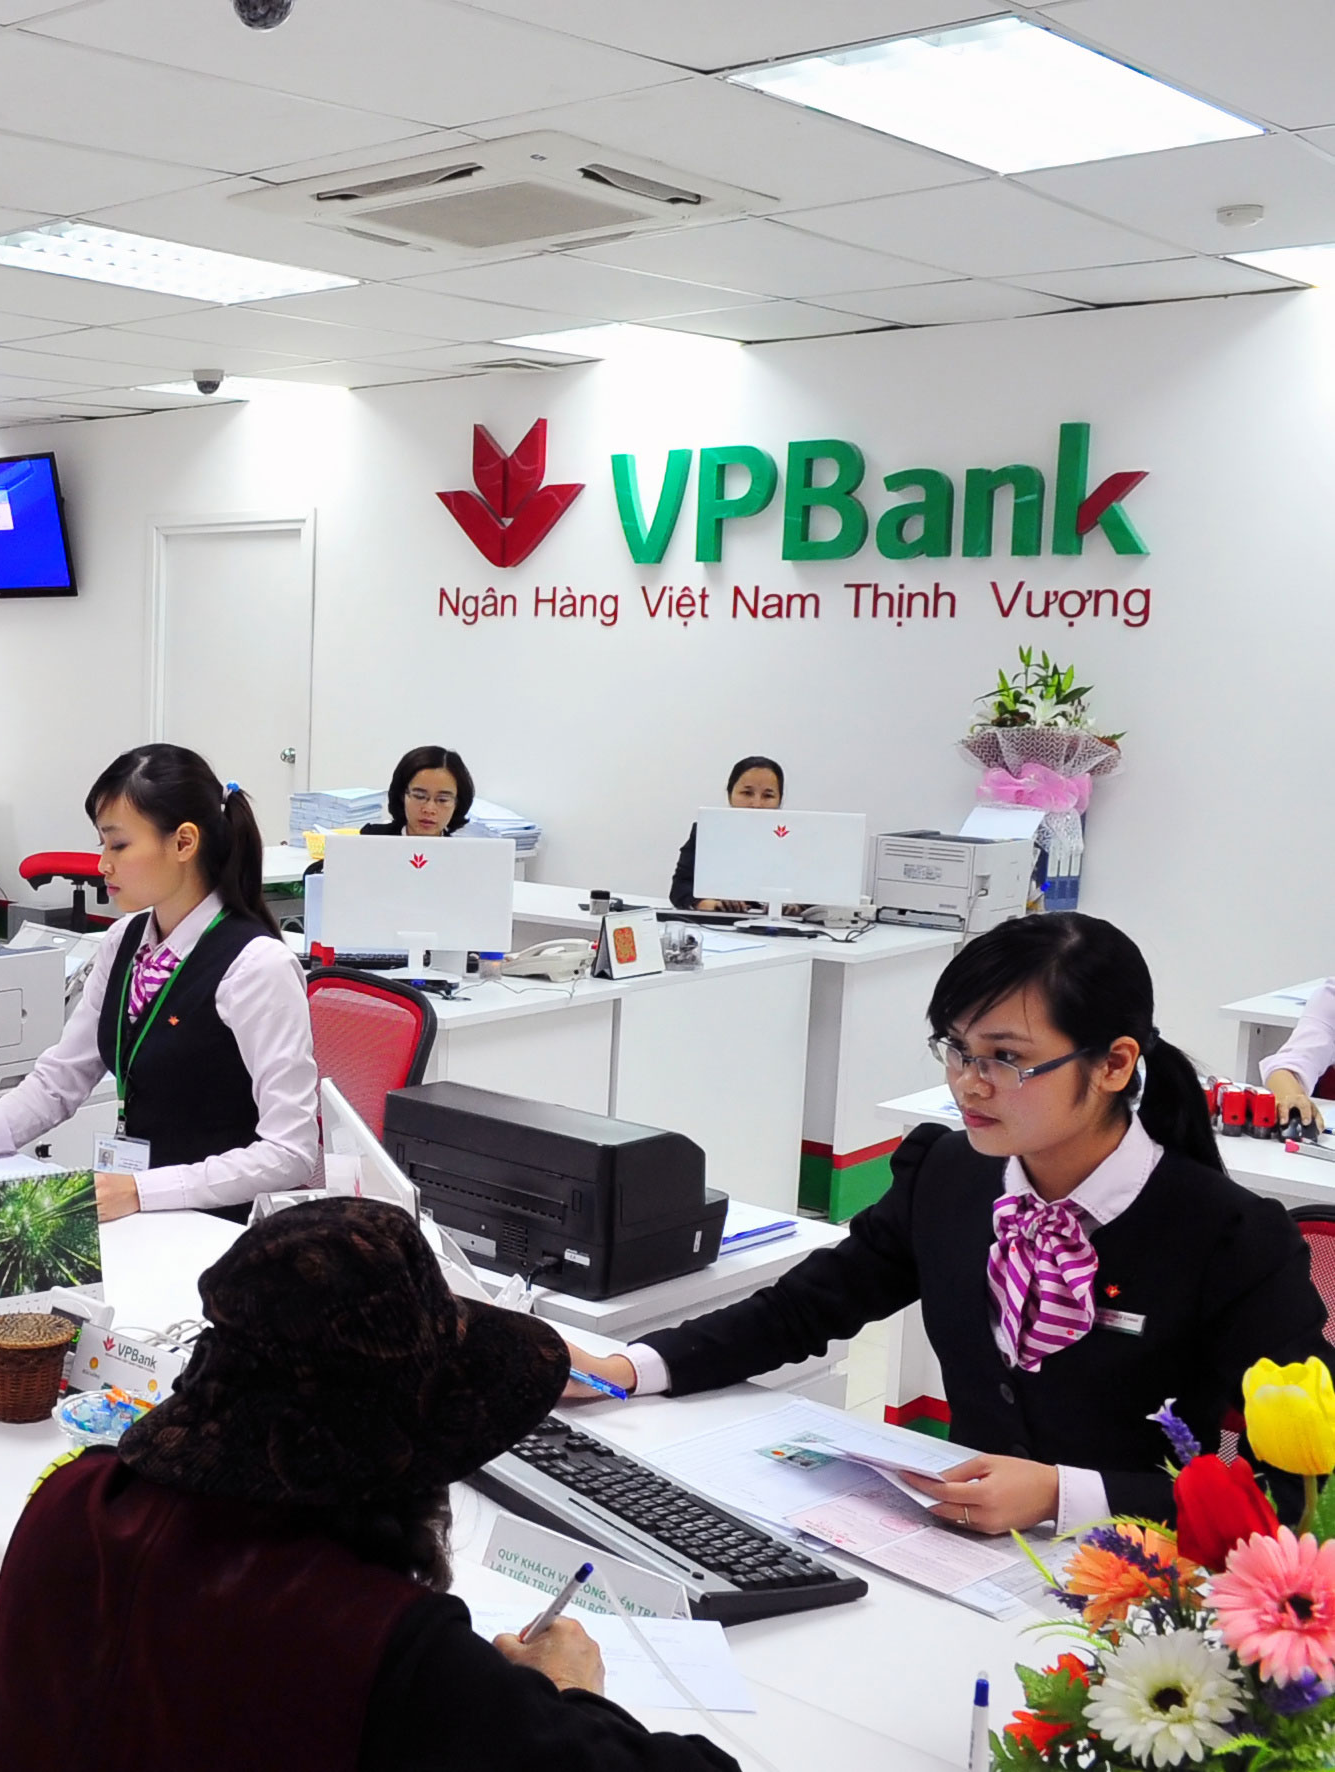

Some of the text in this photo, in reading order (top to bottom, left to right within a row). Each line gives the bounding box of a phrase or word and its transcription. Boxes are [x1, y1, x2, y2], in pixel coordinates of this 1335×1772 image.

[611, 422, 1150, 564] VPBank
[438, 580, 1151, 628] Ngân Hàng Việt Nam Thịnh Vượng
[118, 1342, 158, 1370] VPBank
